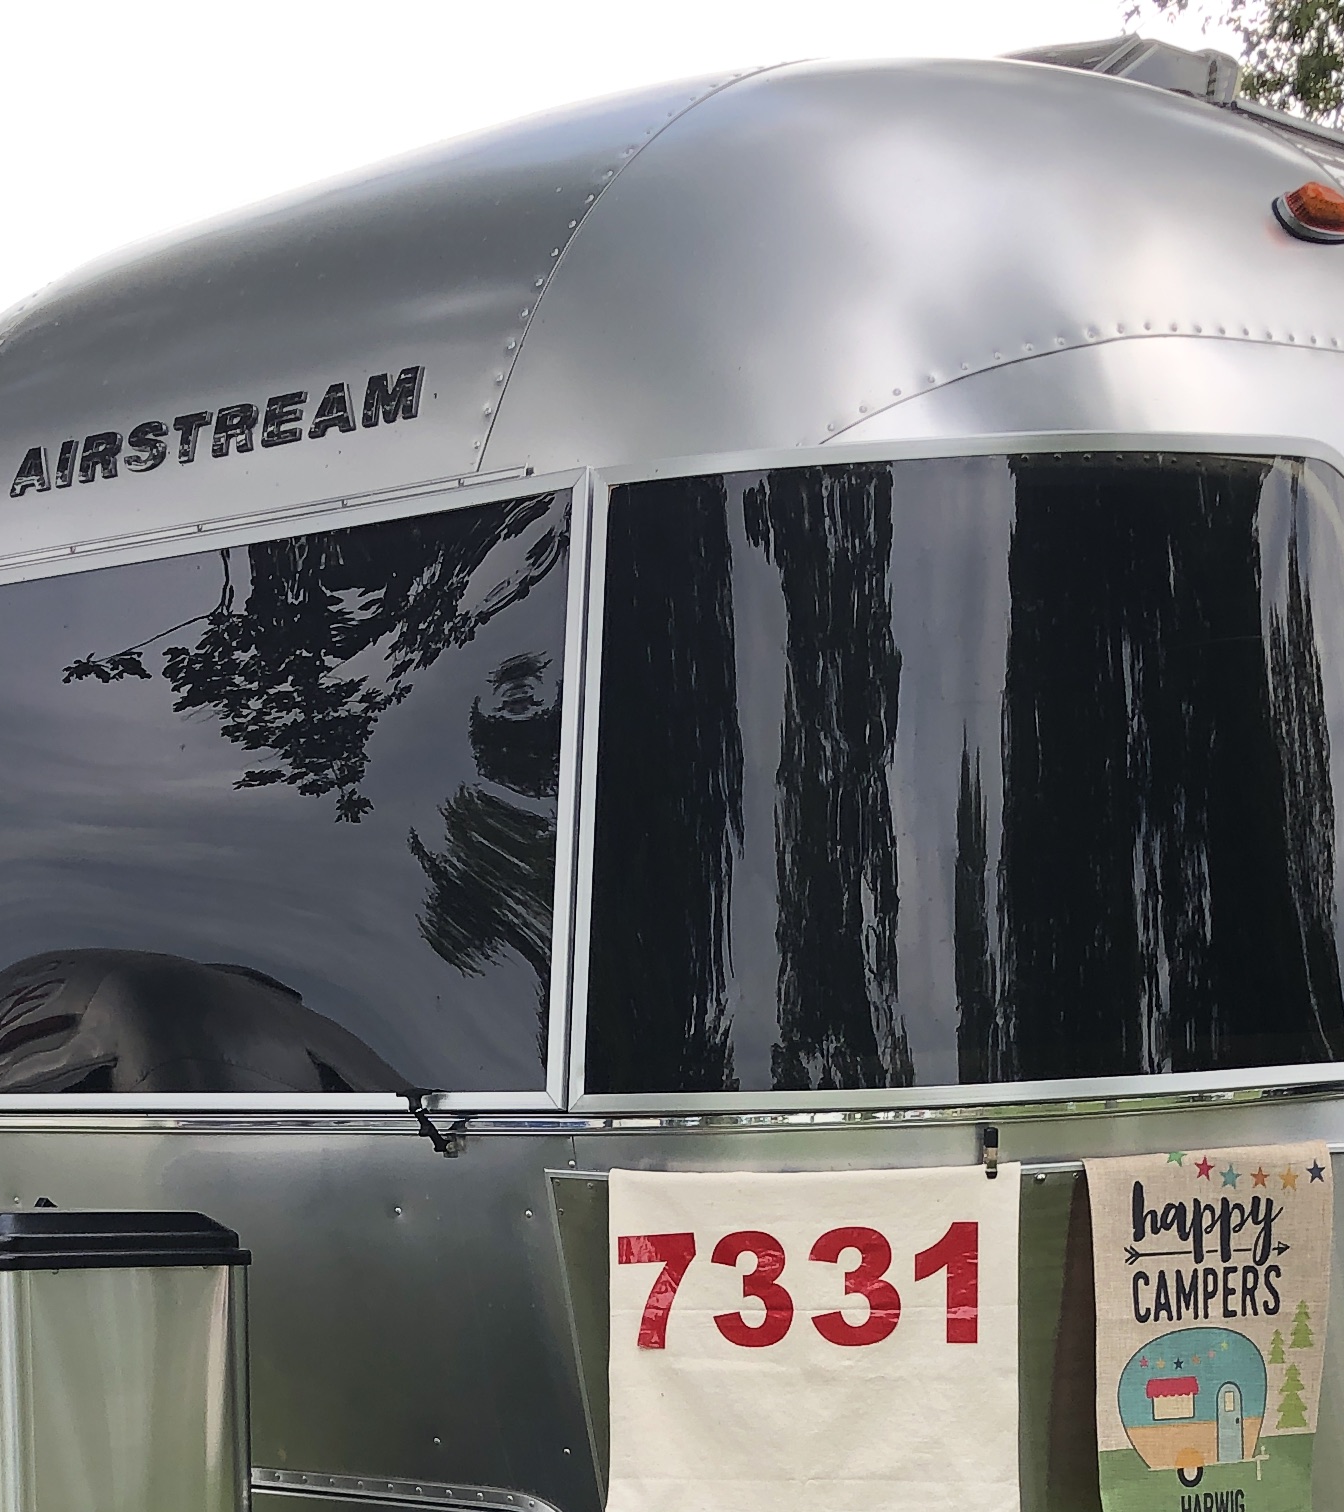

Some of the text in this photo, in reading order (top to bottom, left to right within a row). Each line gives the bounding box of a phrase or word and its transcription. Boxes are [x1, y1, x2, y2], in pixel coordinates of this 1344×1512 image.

[10, 366, 424, 497] AIRSTREAM
[1132, 1181, 1284, 1266] happy
[617, 1221, 980, 1350] 7331
[1132, 1264, 1282, 1323] CAMPERS
